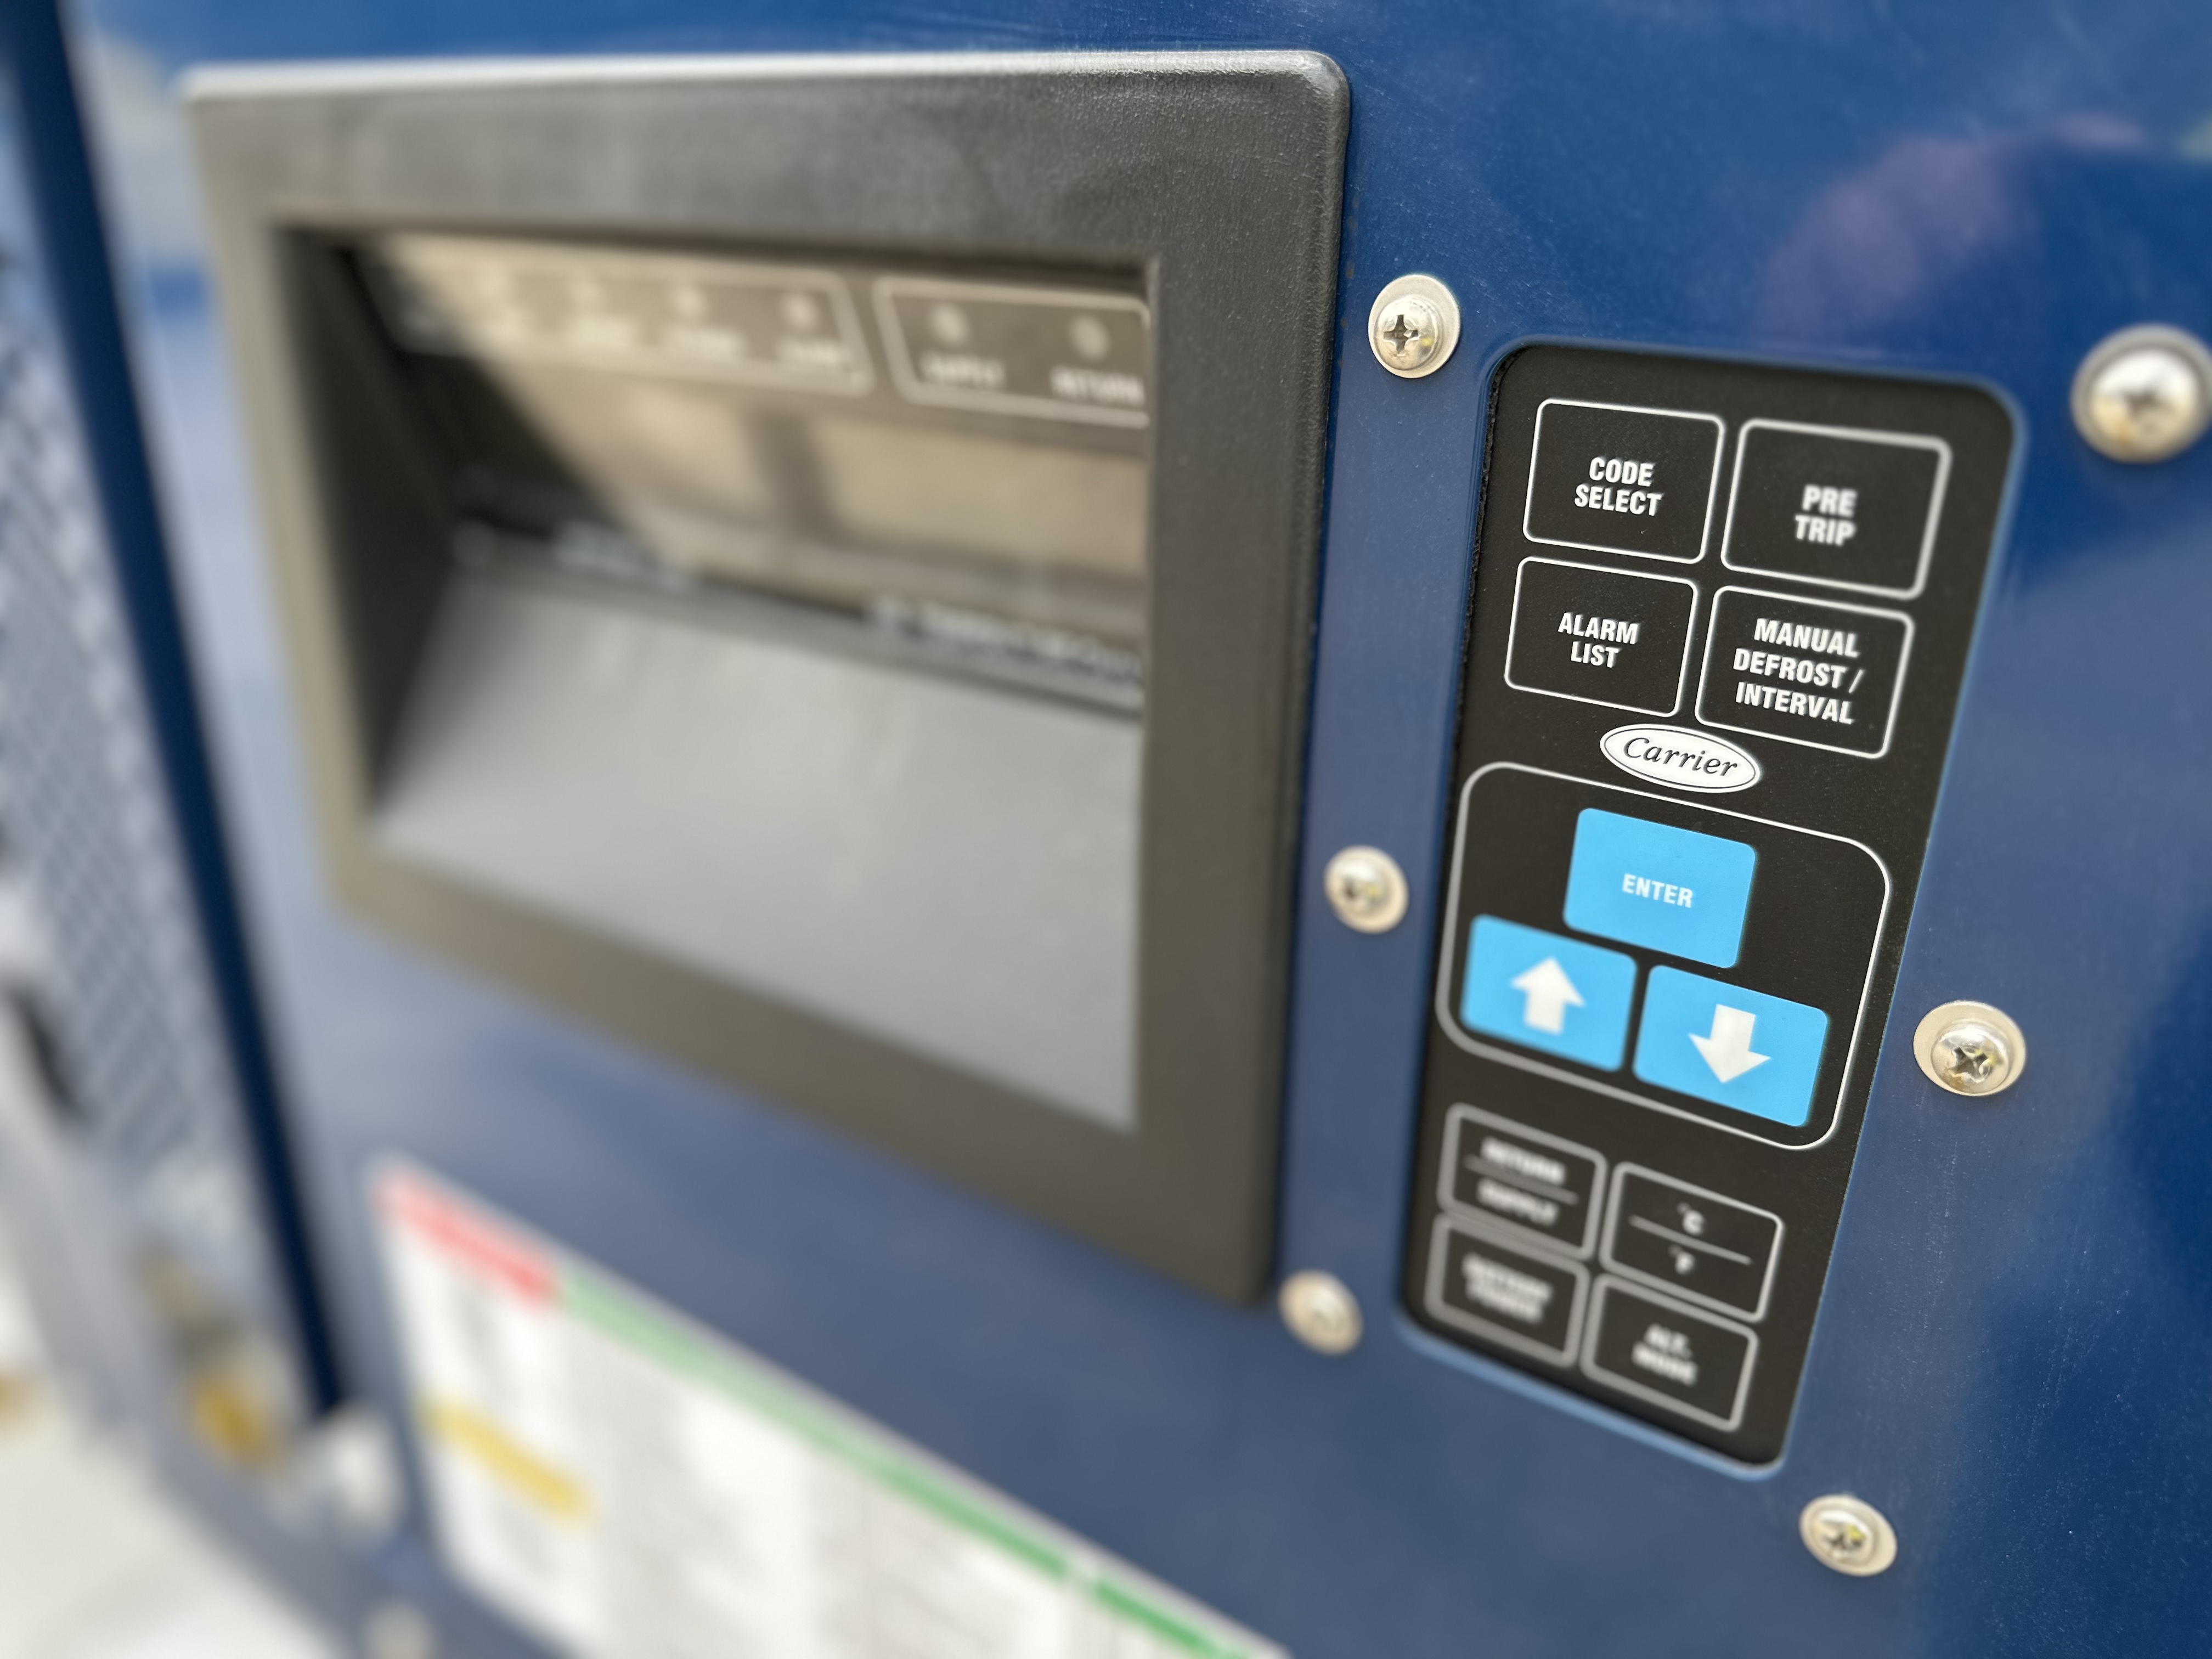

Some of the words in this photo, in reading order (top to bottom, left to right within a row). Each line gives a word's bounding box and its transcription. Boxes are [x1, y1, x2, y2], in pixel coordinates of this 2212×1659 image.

[1589, 455, 1655, 487] CODE
[1574, 483, 1664, 517] SELECT
[1802, 484, 1858, 518] PRE
[1795, 514, 1857, 546] TRIP
[1557, 612, 1640, 645] ALARM
[1753, 618, 1860, 658] MANUAL
[1570, 641, 1621, 669] LIST
[1733, 648, 1848, 690] DEFROST
[1735, 681, 1854, 725] INTERVAL
[1623, 737, 1737, 777] Carrier
[1622, 873, 1693, 909] ENTER
